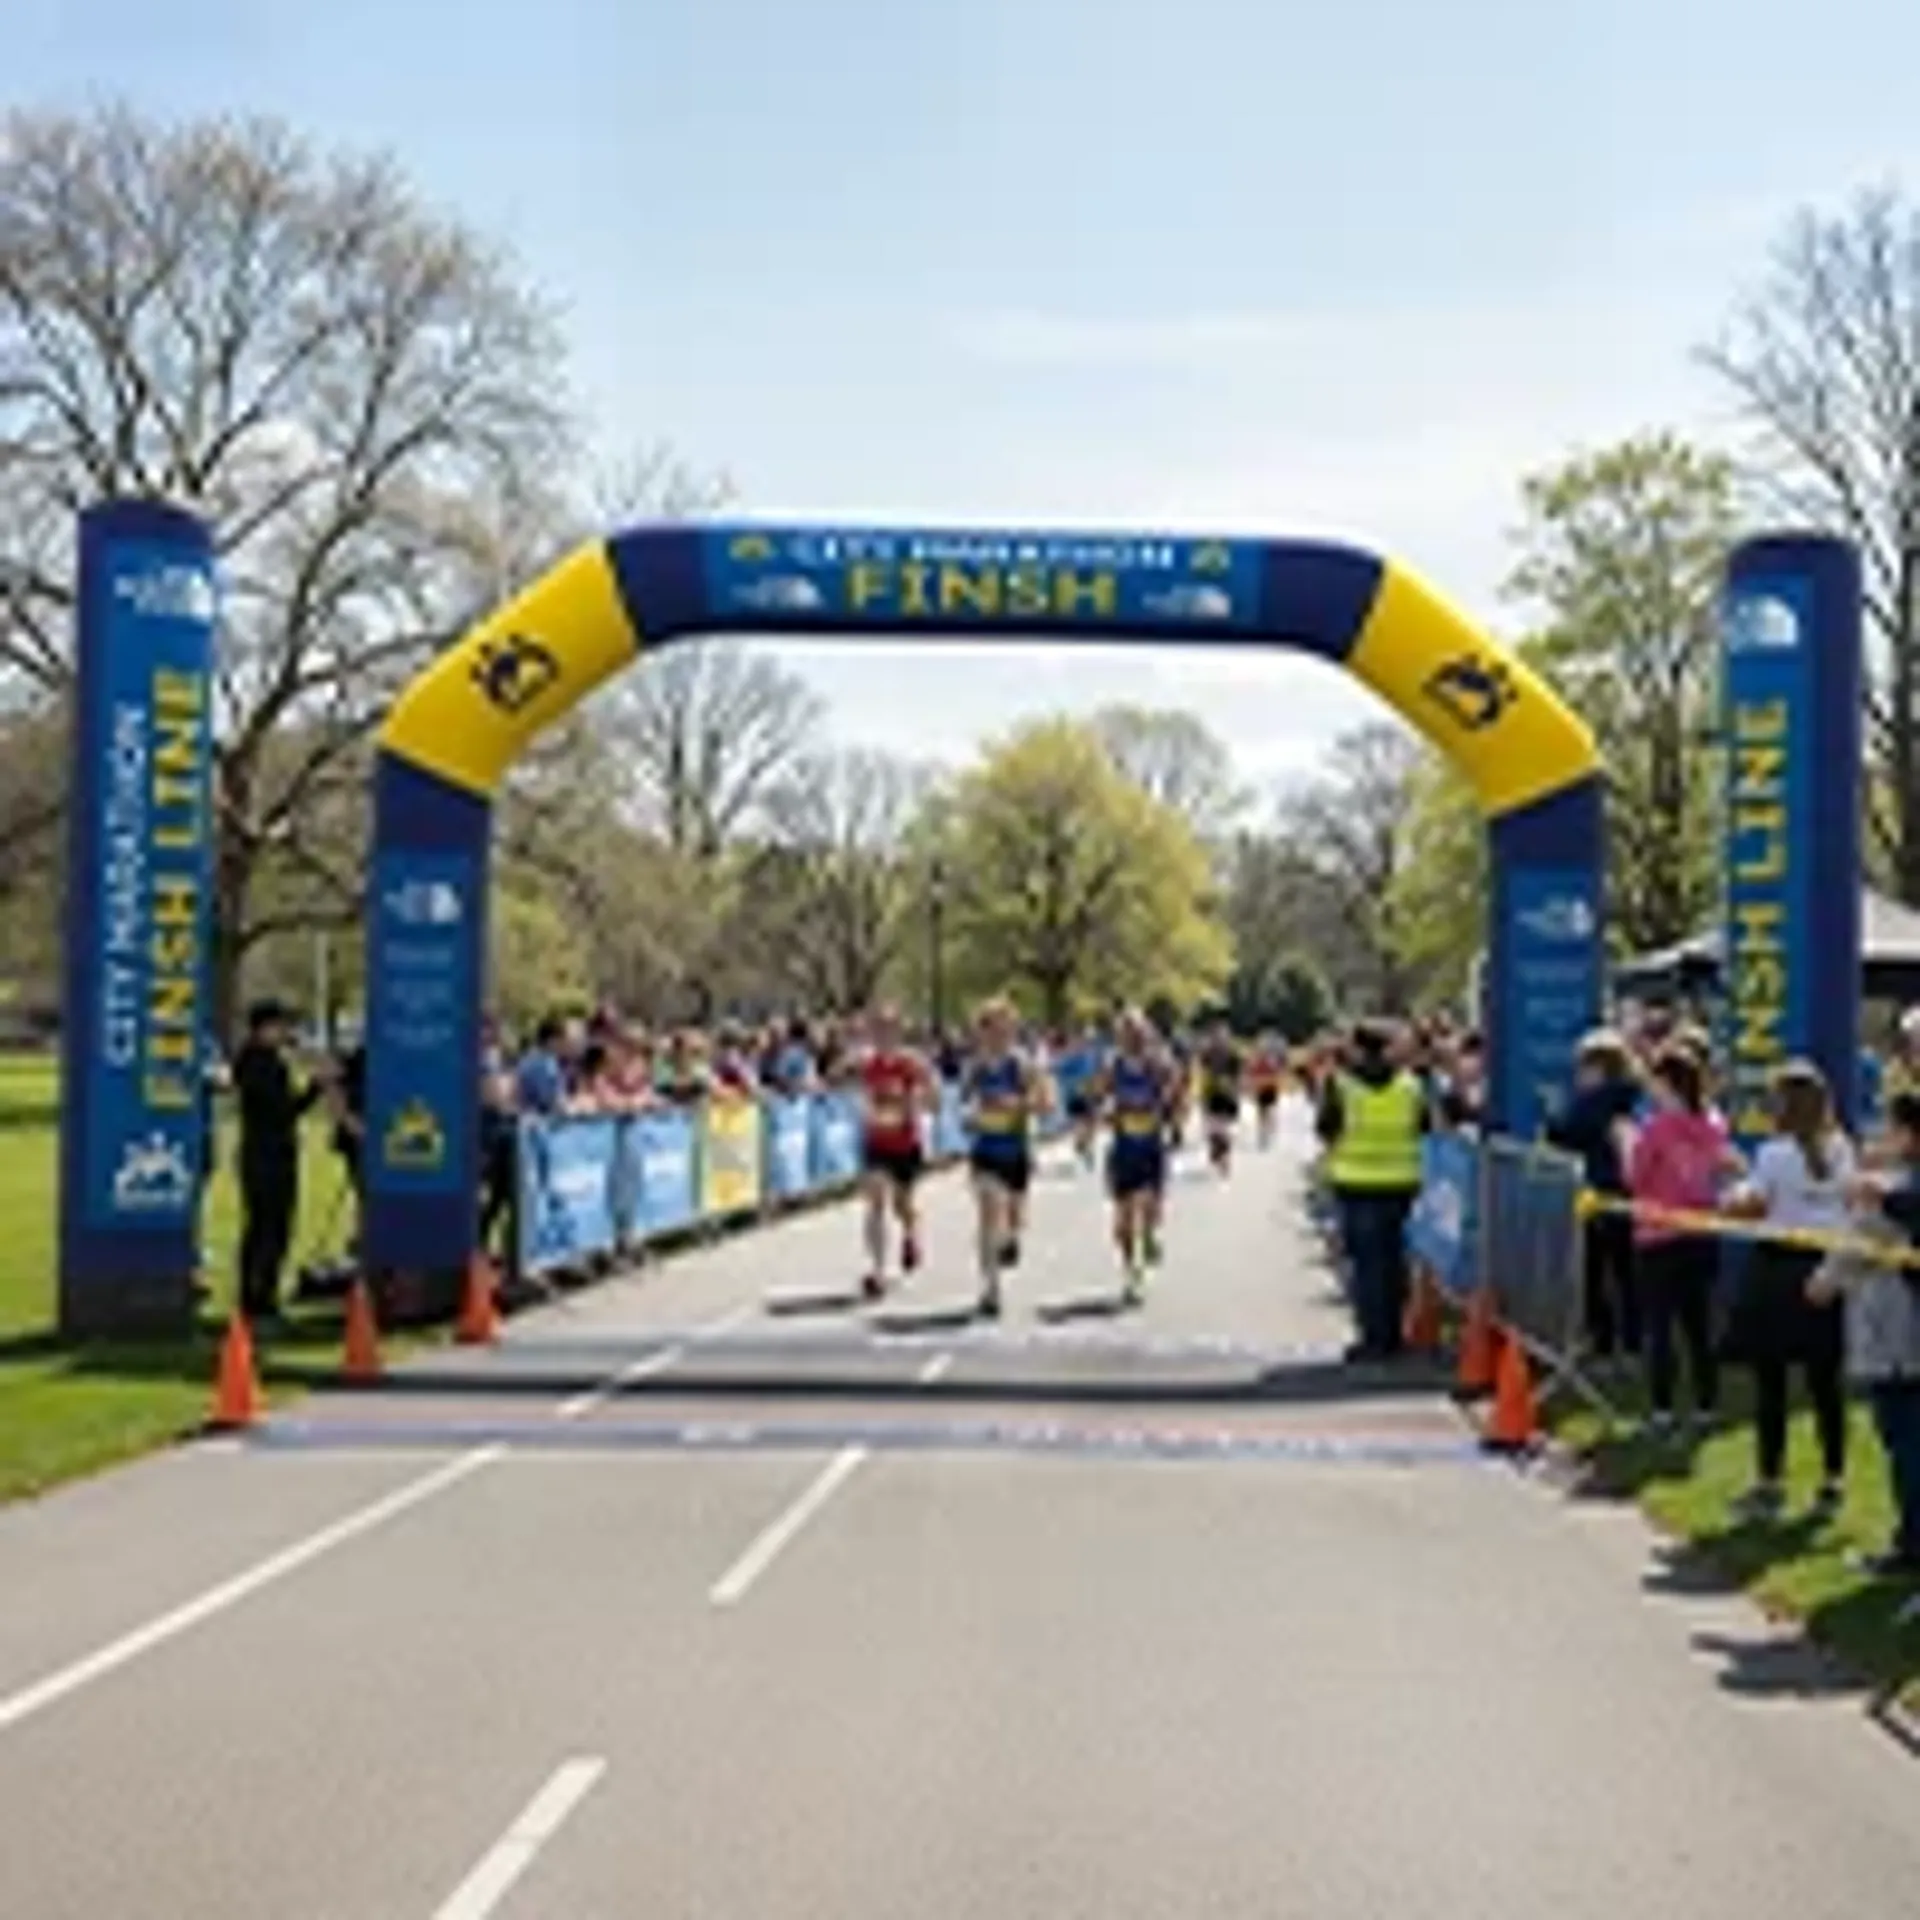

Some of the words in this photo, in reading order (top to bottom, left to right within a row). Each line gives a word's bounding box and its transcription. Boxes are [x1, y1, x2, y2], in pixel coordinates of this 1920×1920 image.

[151, 671, 204, 848] LINE
[1734, 698, 1788, 876] LINE
[102, 963, 138, 1068] CITY
[144, 873, 198, 1109] FINSH
